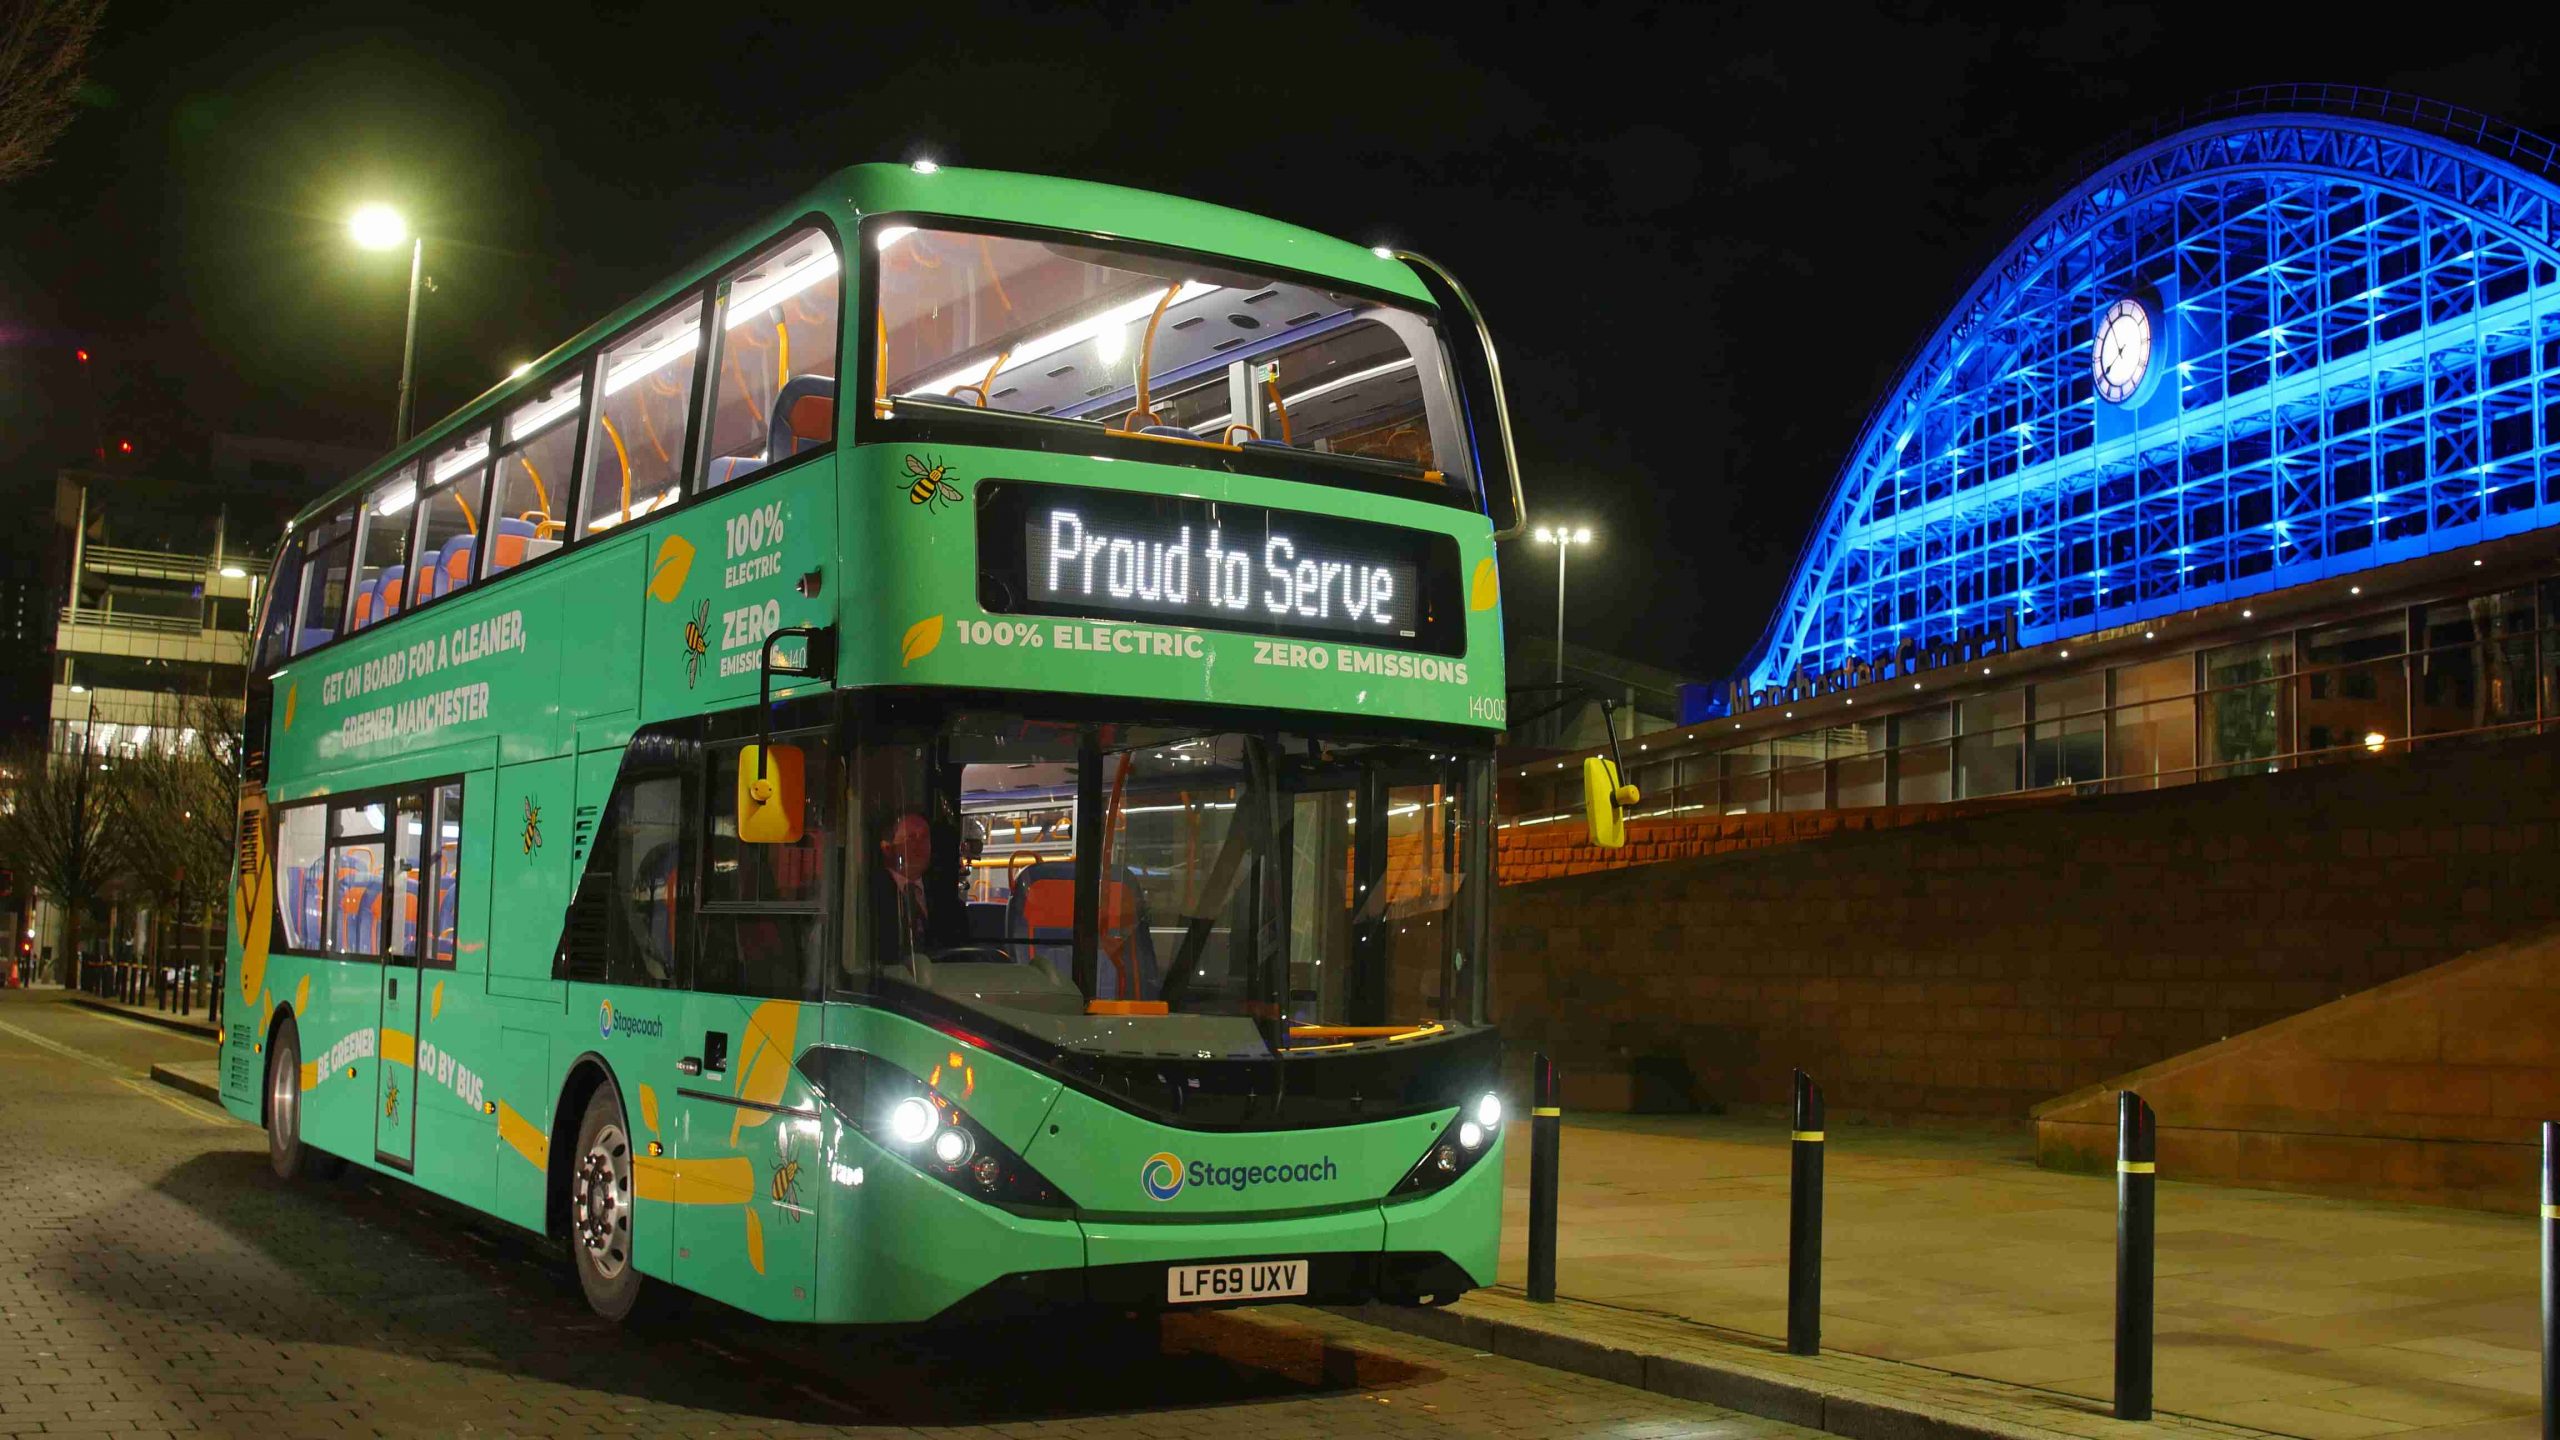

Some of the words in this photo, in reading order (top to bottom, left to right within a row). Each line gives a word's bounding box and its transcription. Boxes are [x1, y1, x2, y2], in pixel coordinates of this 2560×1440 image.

[726, 501, 784, 560] 100%
[725, 551, 782, 589] ELECTRIC
[1049, 510, 1190, 603] Proud
[1205, 528, 1250, 608] to
[1264, 536, 1393, 623] Serve
[721, 599, 780, 651] ZERO
[956, 620, 1043, 648] 100%
[1053, 625, 1205, 659] ELECTRIC
[322, 671, 344, 705] GET
[344, 664, 362, 699] ON
[363, 650, 406, 694] BOARD
[408, 639, 435, 680] FOR
[437, 634, 448, 671] A
[451, 610, 526, 666] CLEANER,
[1253, 640, 1329, 669] ZERO
[1337, 649, 1469, 685] EMISSIONS
[342, 705, 395, 748] GREENER
[395, 682, 489, 737] MANCHESTER
[613, 1008, 663, 1038] Stagecoach
[317, 1051, 330, 1084] BE
[331, 1027, 375, 1072] GREENER
[418, 1040, 436, 1076] GO
[437, 1050, 456, 1088] BY
[457, 1064, 484, 1112] BUS
[1187, 1155, 1337, 1191] Stagecoach
[1179, 1267, 1243, 1297] LF69
[1251, 1265, 1297, 1292] UXV
